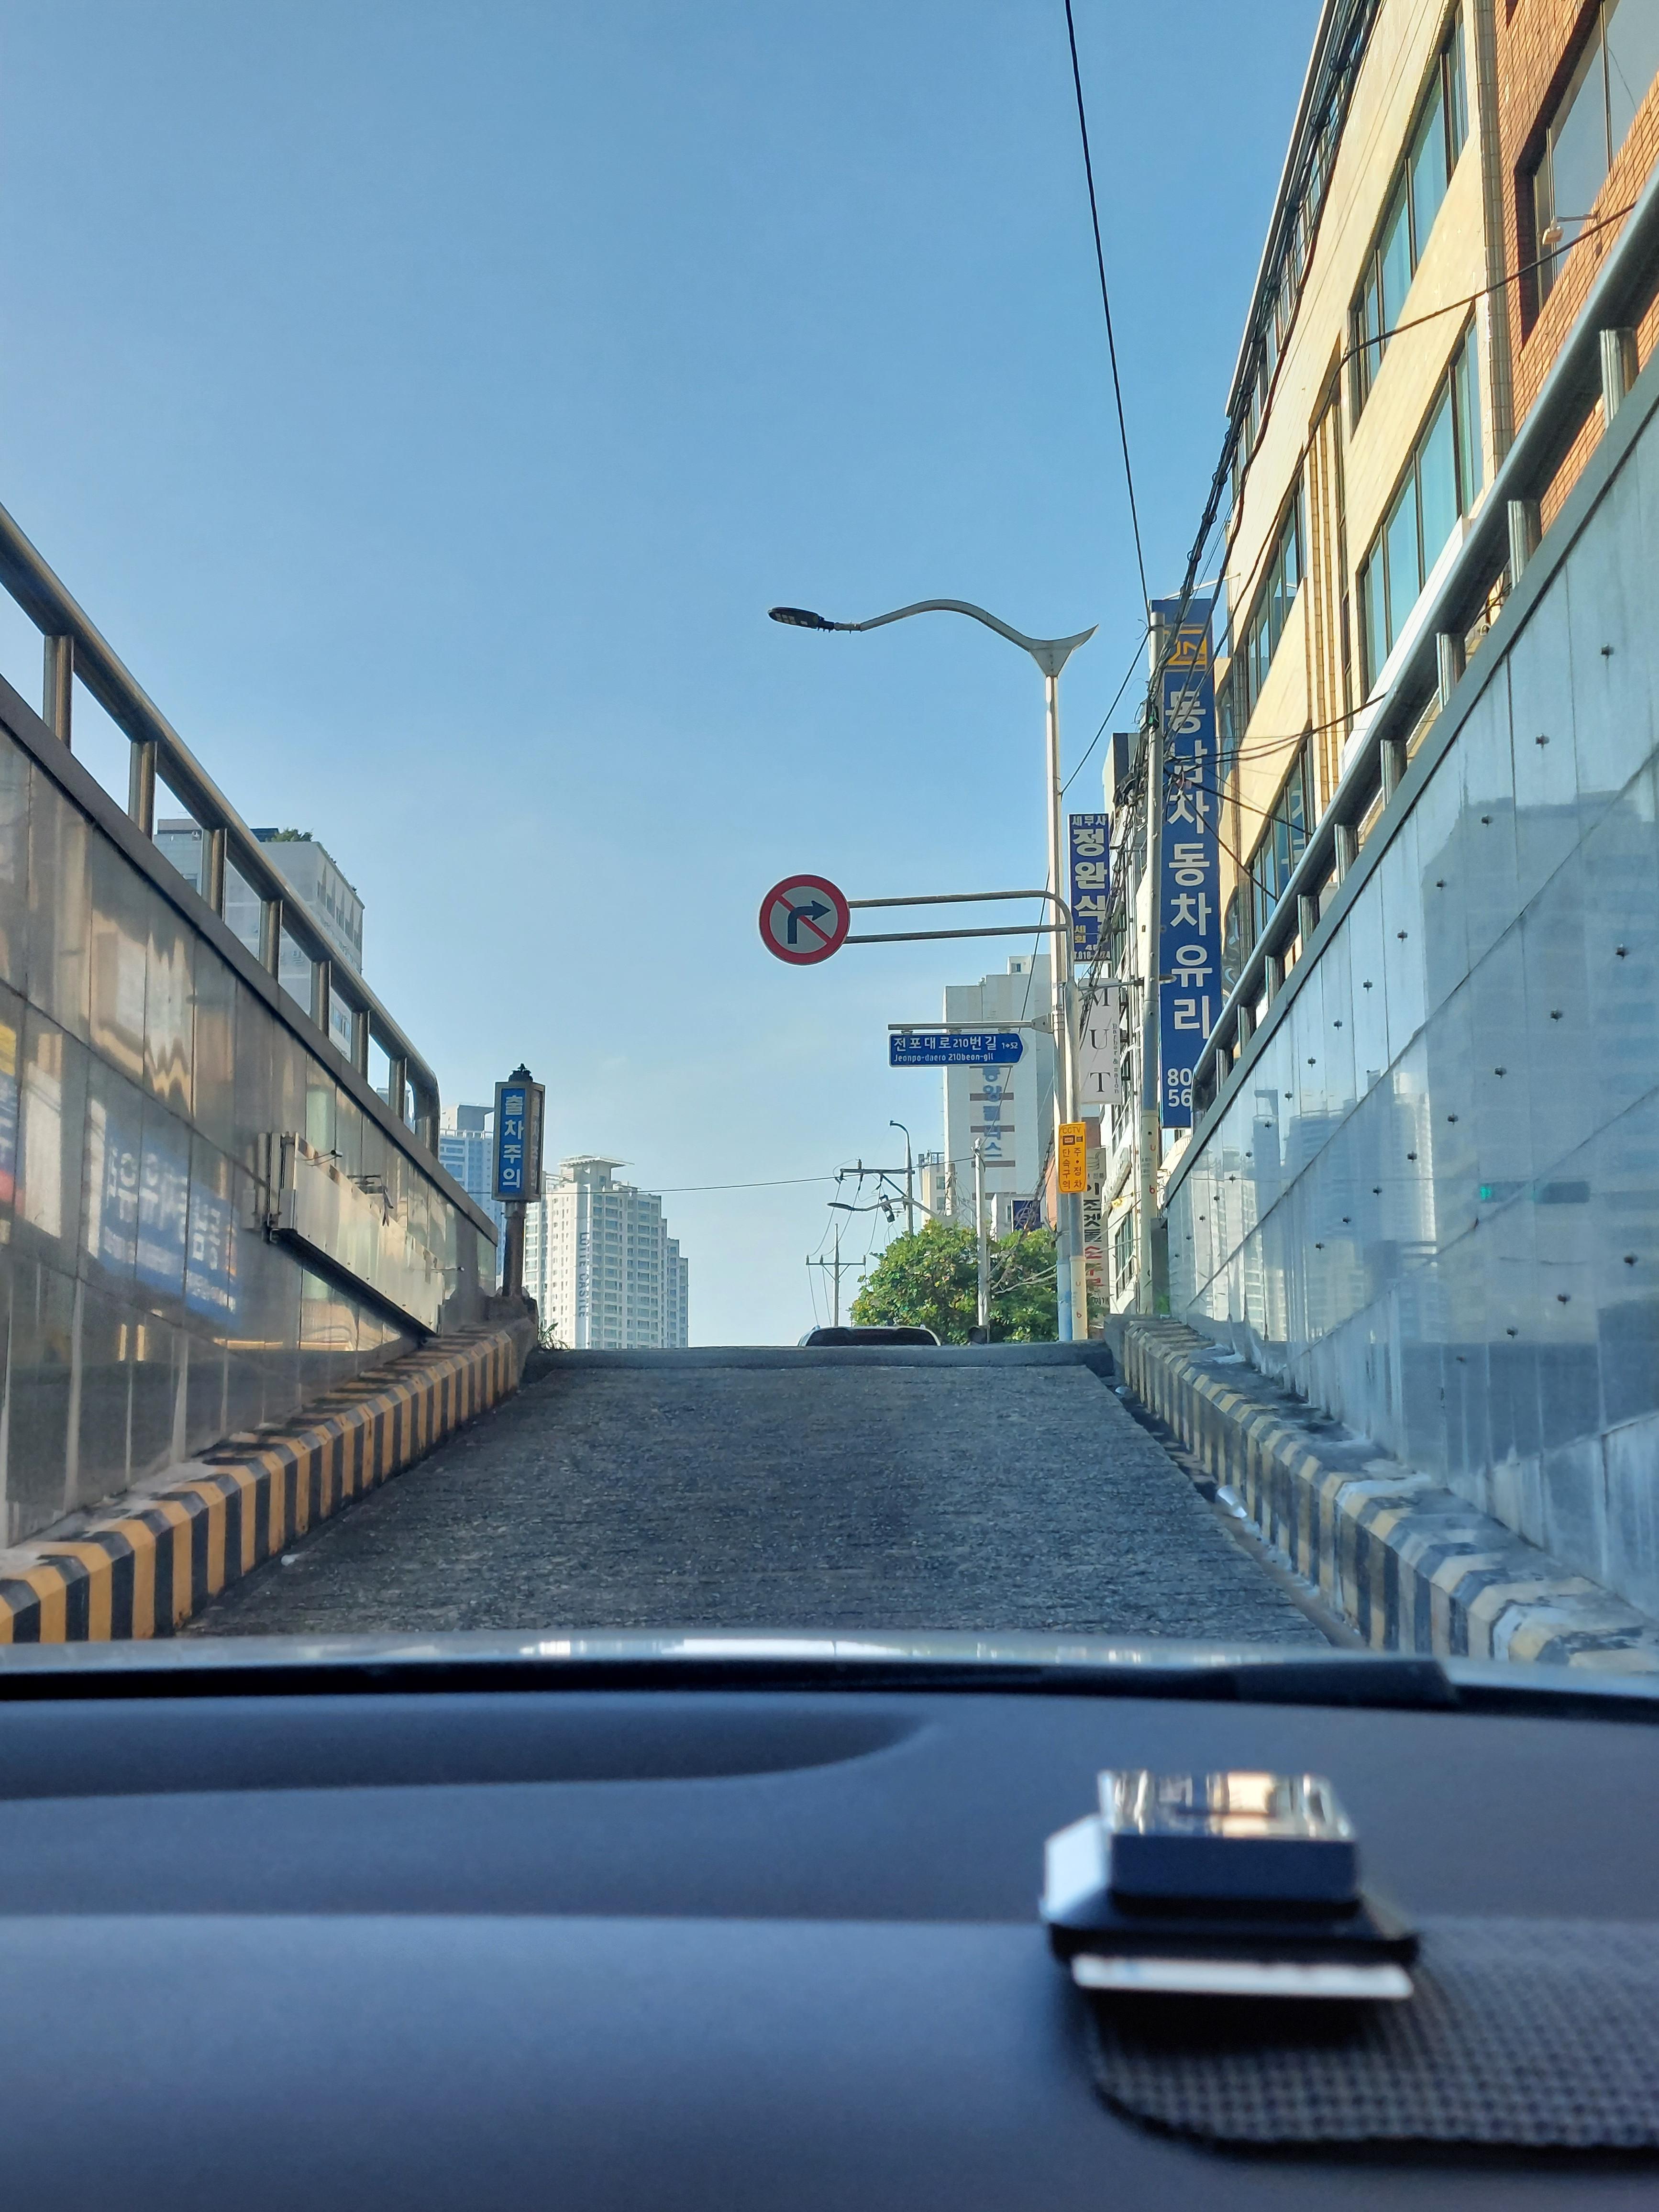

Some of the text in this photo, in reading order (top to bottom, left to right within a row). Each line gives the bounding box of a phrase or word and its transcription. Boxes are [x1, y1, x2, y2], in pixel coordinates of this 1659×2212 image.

[1072, 815, 1106, 827] 세무사
[1073, 829, 1108, 923] 정완식
[894, 1053, 946, 1063] Jeonpo-daero
[502, 1095, 524, 1188] 출차주의
